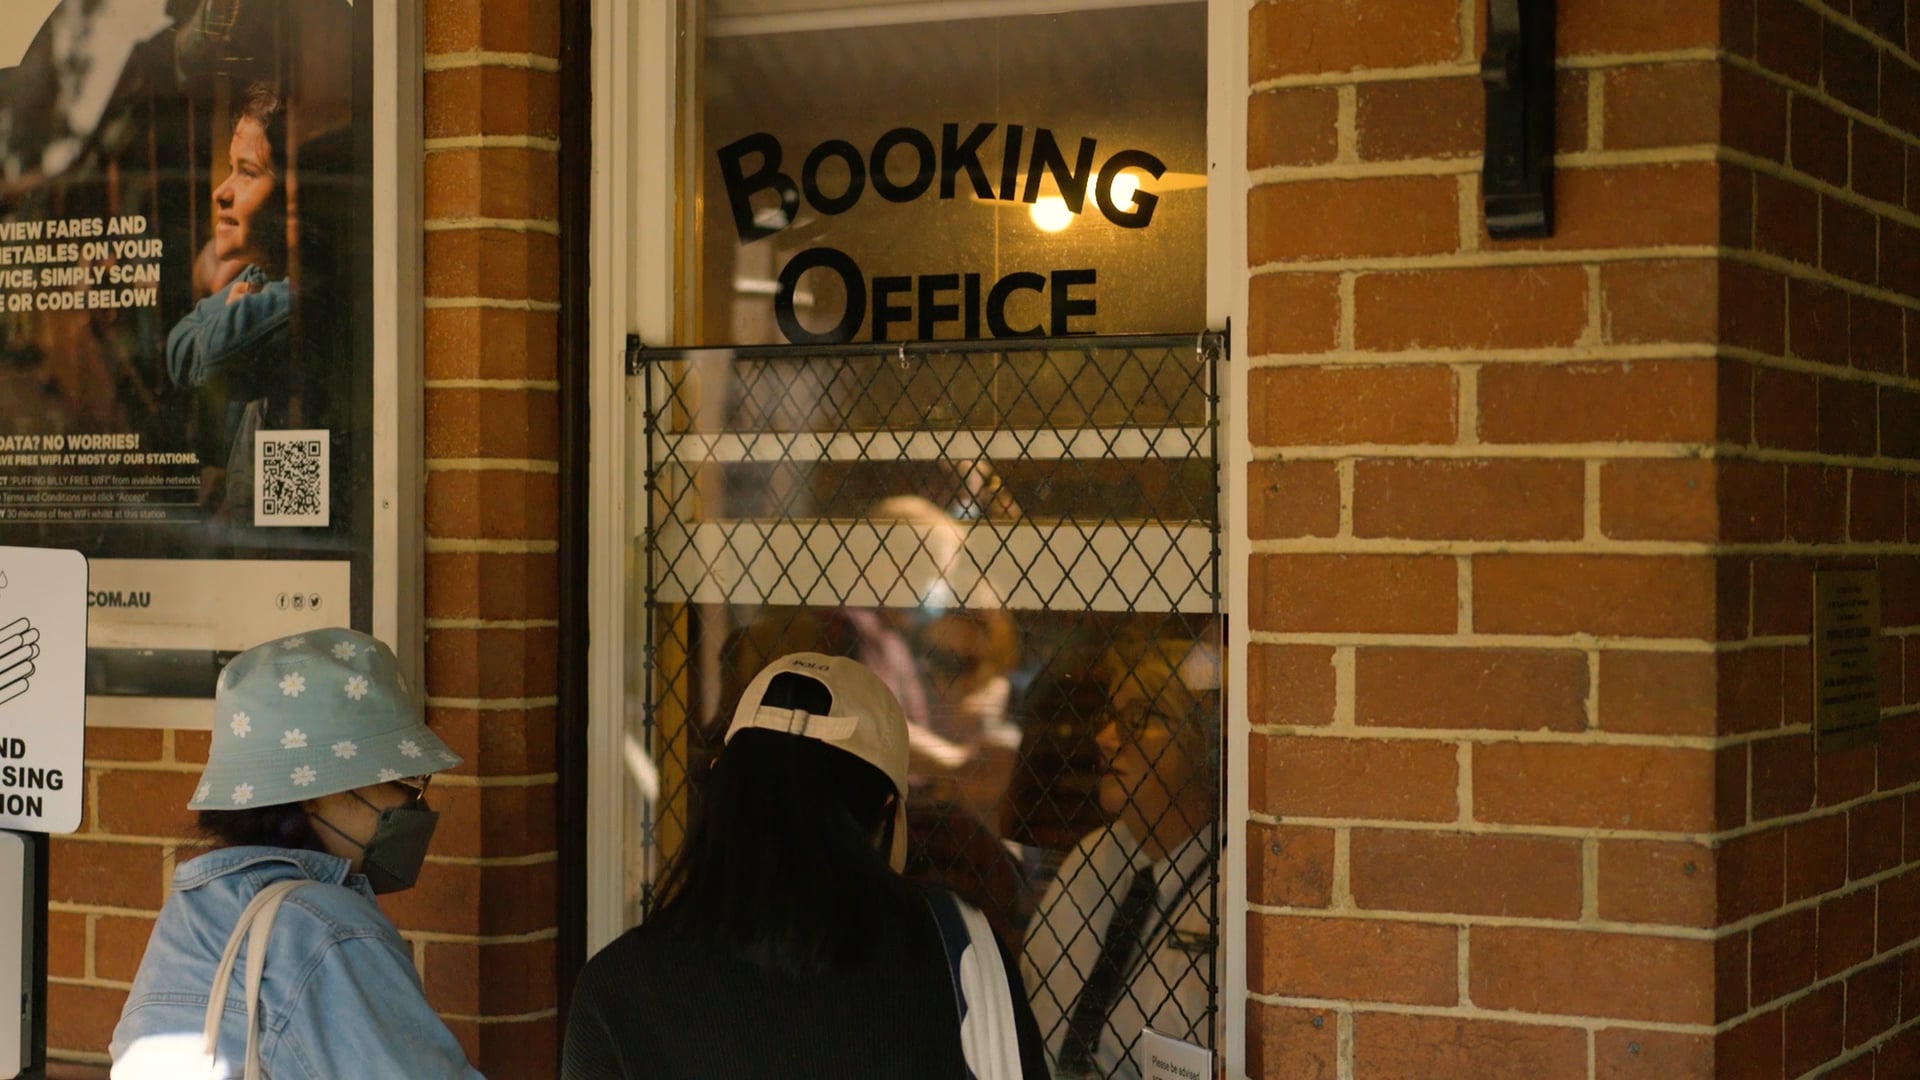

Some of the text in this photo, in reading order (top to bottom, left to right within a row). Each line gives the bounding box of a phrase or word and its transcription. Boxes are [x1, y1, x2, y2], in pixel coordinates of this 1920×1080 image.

[0, 215, 147, 241] VIEW FARES AND
[82, 241, 109, 261] ON
[113, 239, 163, 259] YOUR
[41, 266, 106, 287] SIMPLY
[109, 264, 160, 284] SCAN
[8, 293, 33, 312] QR
[36, 291, 85, 311] CODE
[88, 288, 157, 309] BELOW!
[43, 434, 65, 450] NO
[67, 433, 140, 450] WORRIES!
[0, 453, 200, 466] VE FREE WIFI AT MOST OF OUR STATIONS.
[70, 476, 90, 486] FREE
[112, 475, 130, 485] from
[131, 475, 165, 485] available
[165, 475, 201, 485] networks
[2, 492, 25, 502] Terms
[27, 492, 40, 502] and
[41, 492, 81, 502] Conditions
[82, 492, 97, 502] and
[98, 492, 114, 502] click
[18, 509, 47, 519] minutes
[48, 509, 57, 518] of
[58, 508, 73, 518] free
[114, 509, 122, 518] at
[123, 508, 139, 518] this
[140, 508, 166, 518] station
[88, 591, 151, 608] COM.AU
[793, 660, 830, 672] POLO
[2, 766, 63, 791] SING
[1152, 1055, 1200, 1080] Please be advised
